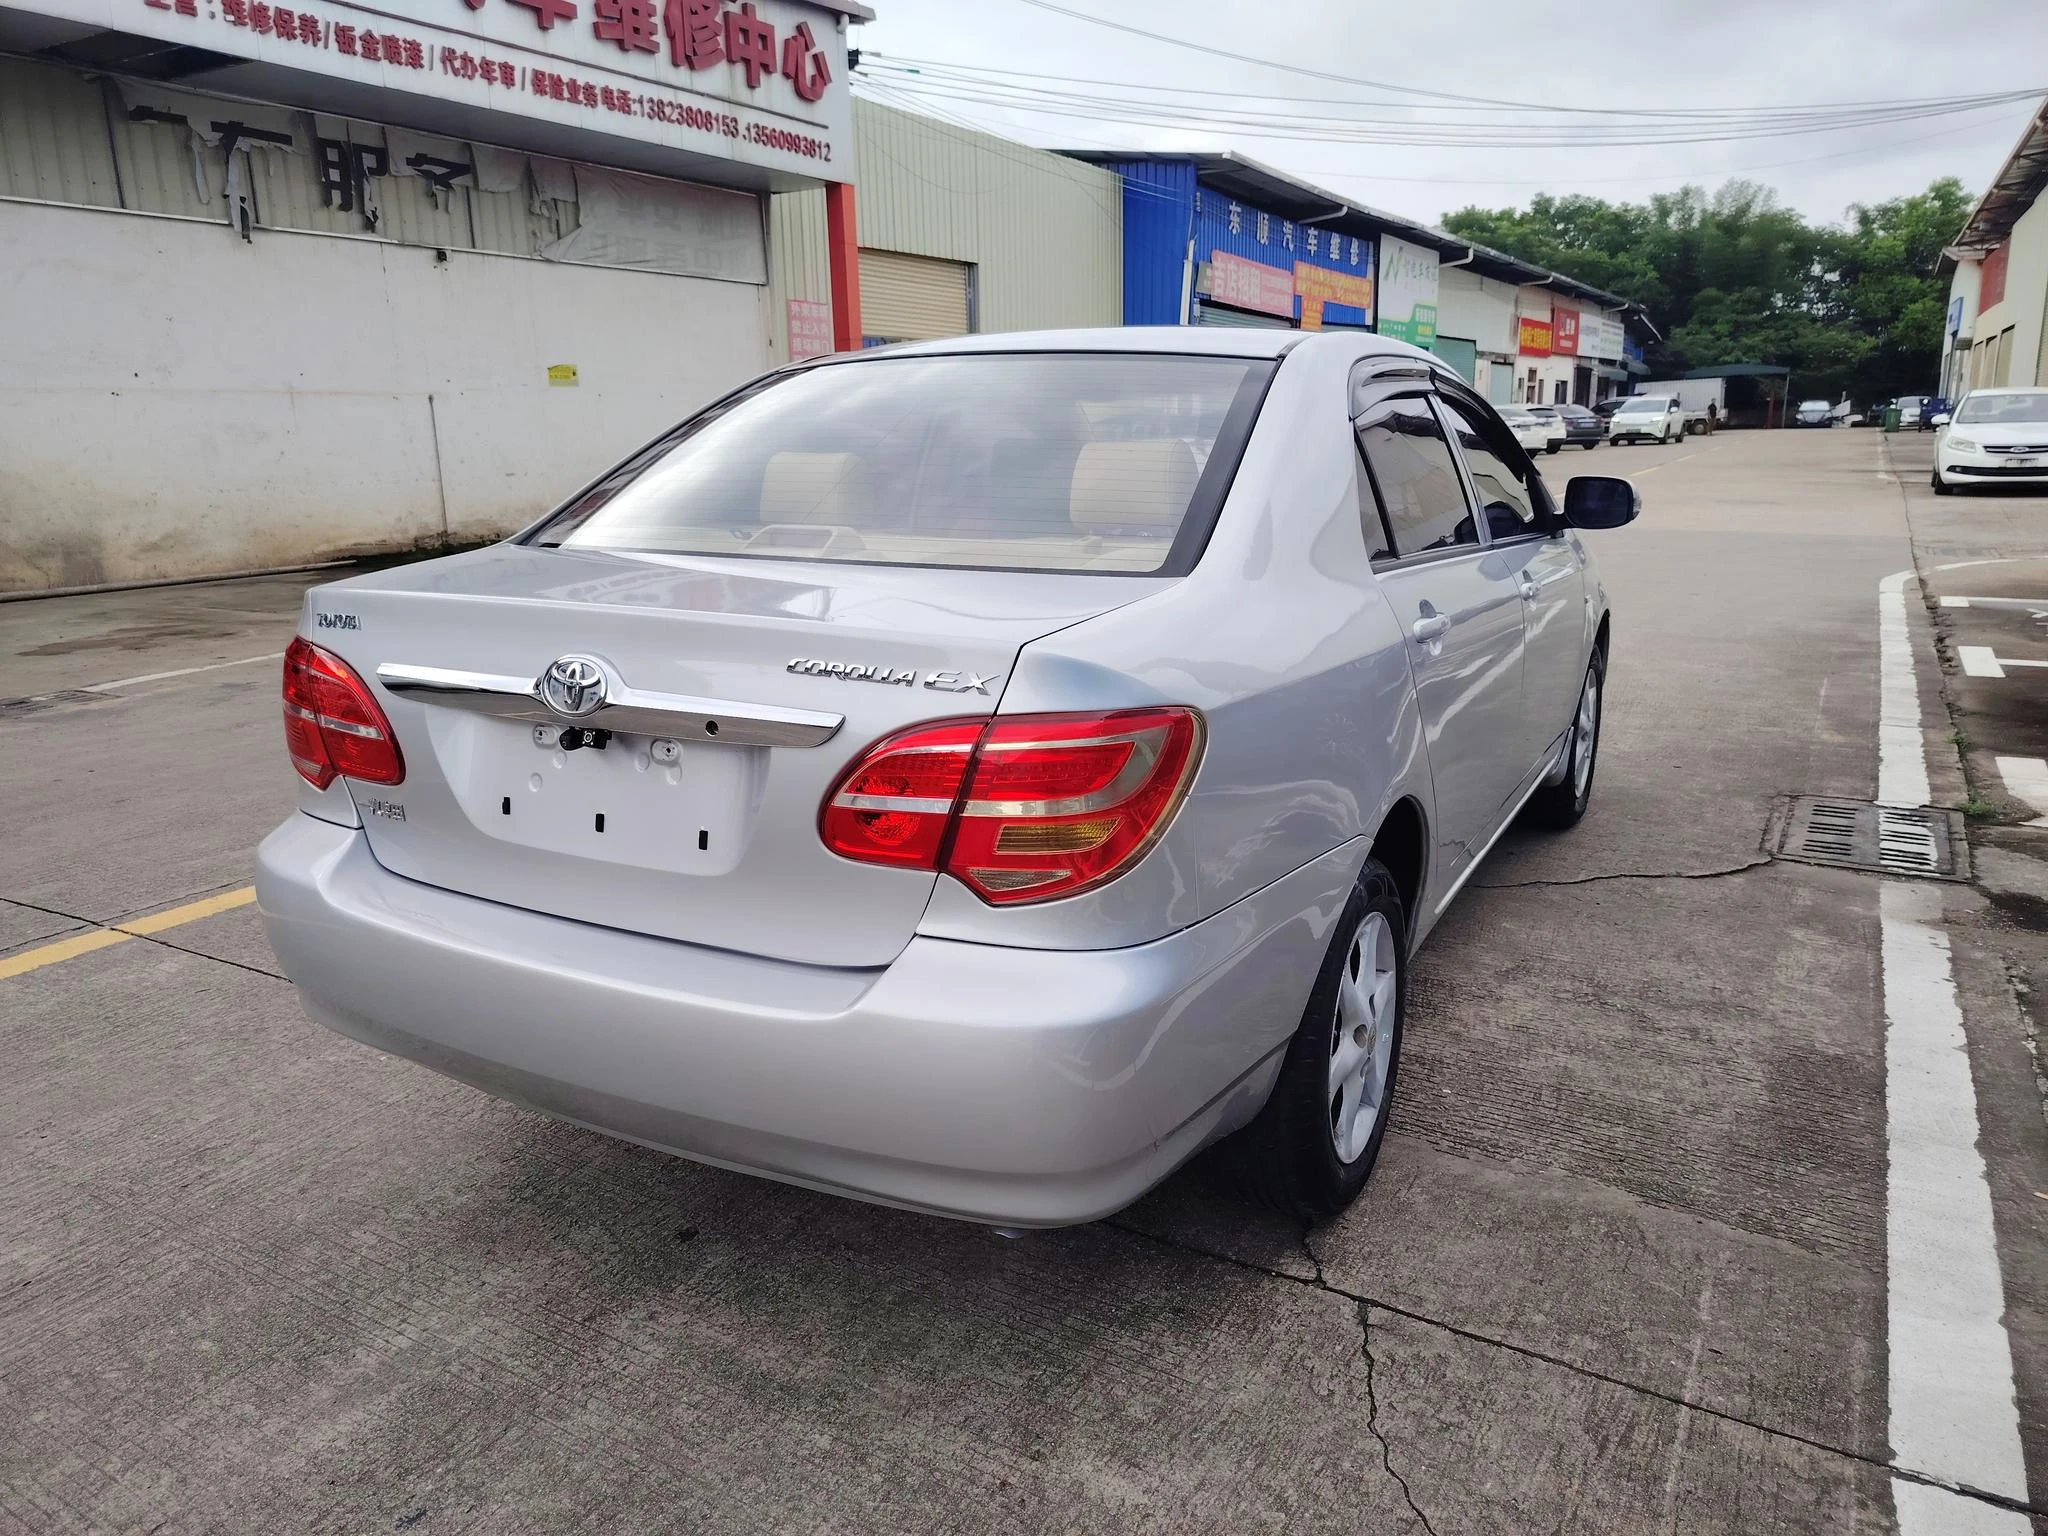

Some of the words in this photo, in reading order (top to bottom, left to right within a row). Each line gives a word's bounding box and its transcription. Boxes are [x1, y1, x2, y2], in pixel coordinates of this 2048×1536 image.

[465, 0, 832, 103] 维修中心
[786, 657, 917, 687] COROLLA
[923, 671, 1001, 696] EX
